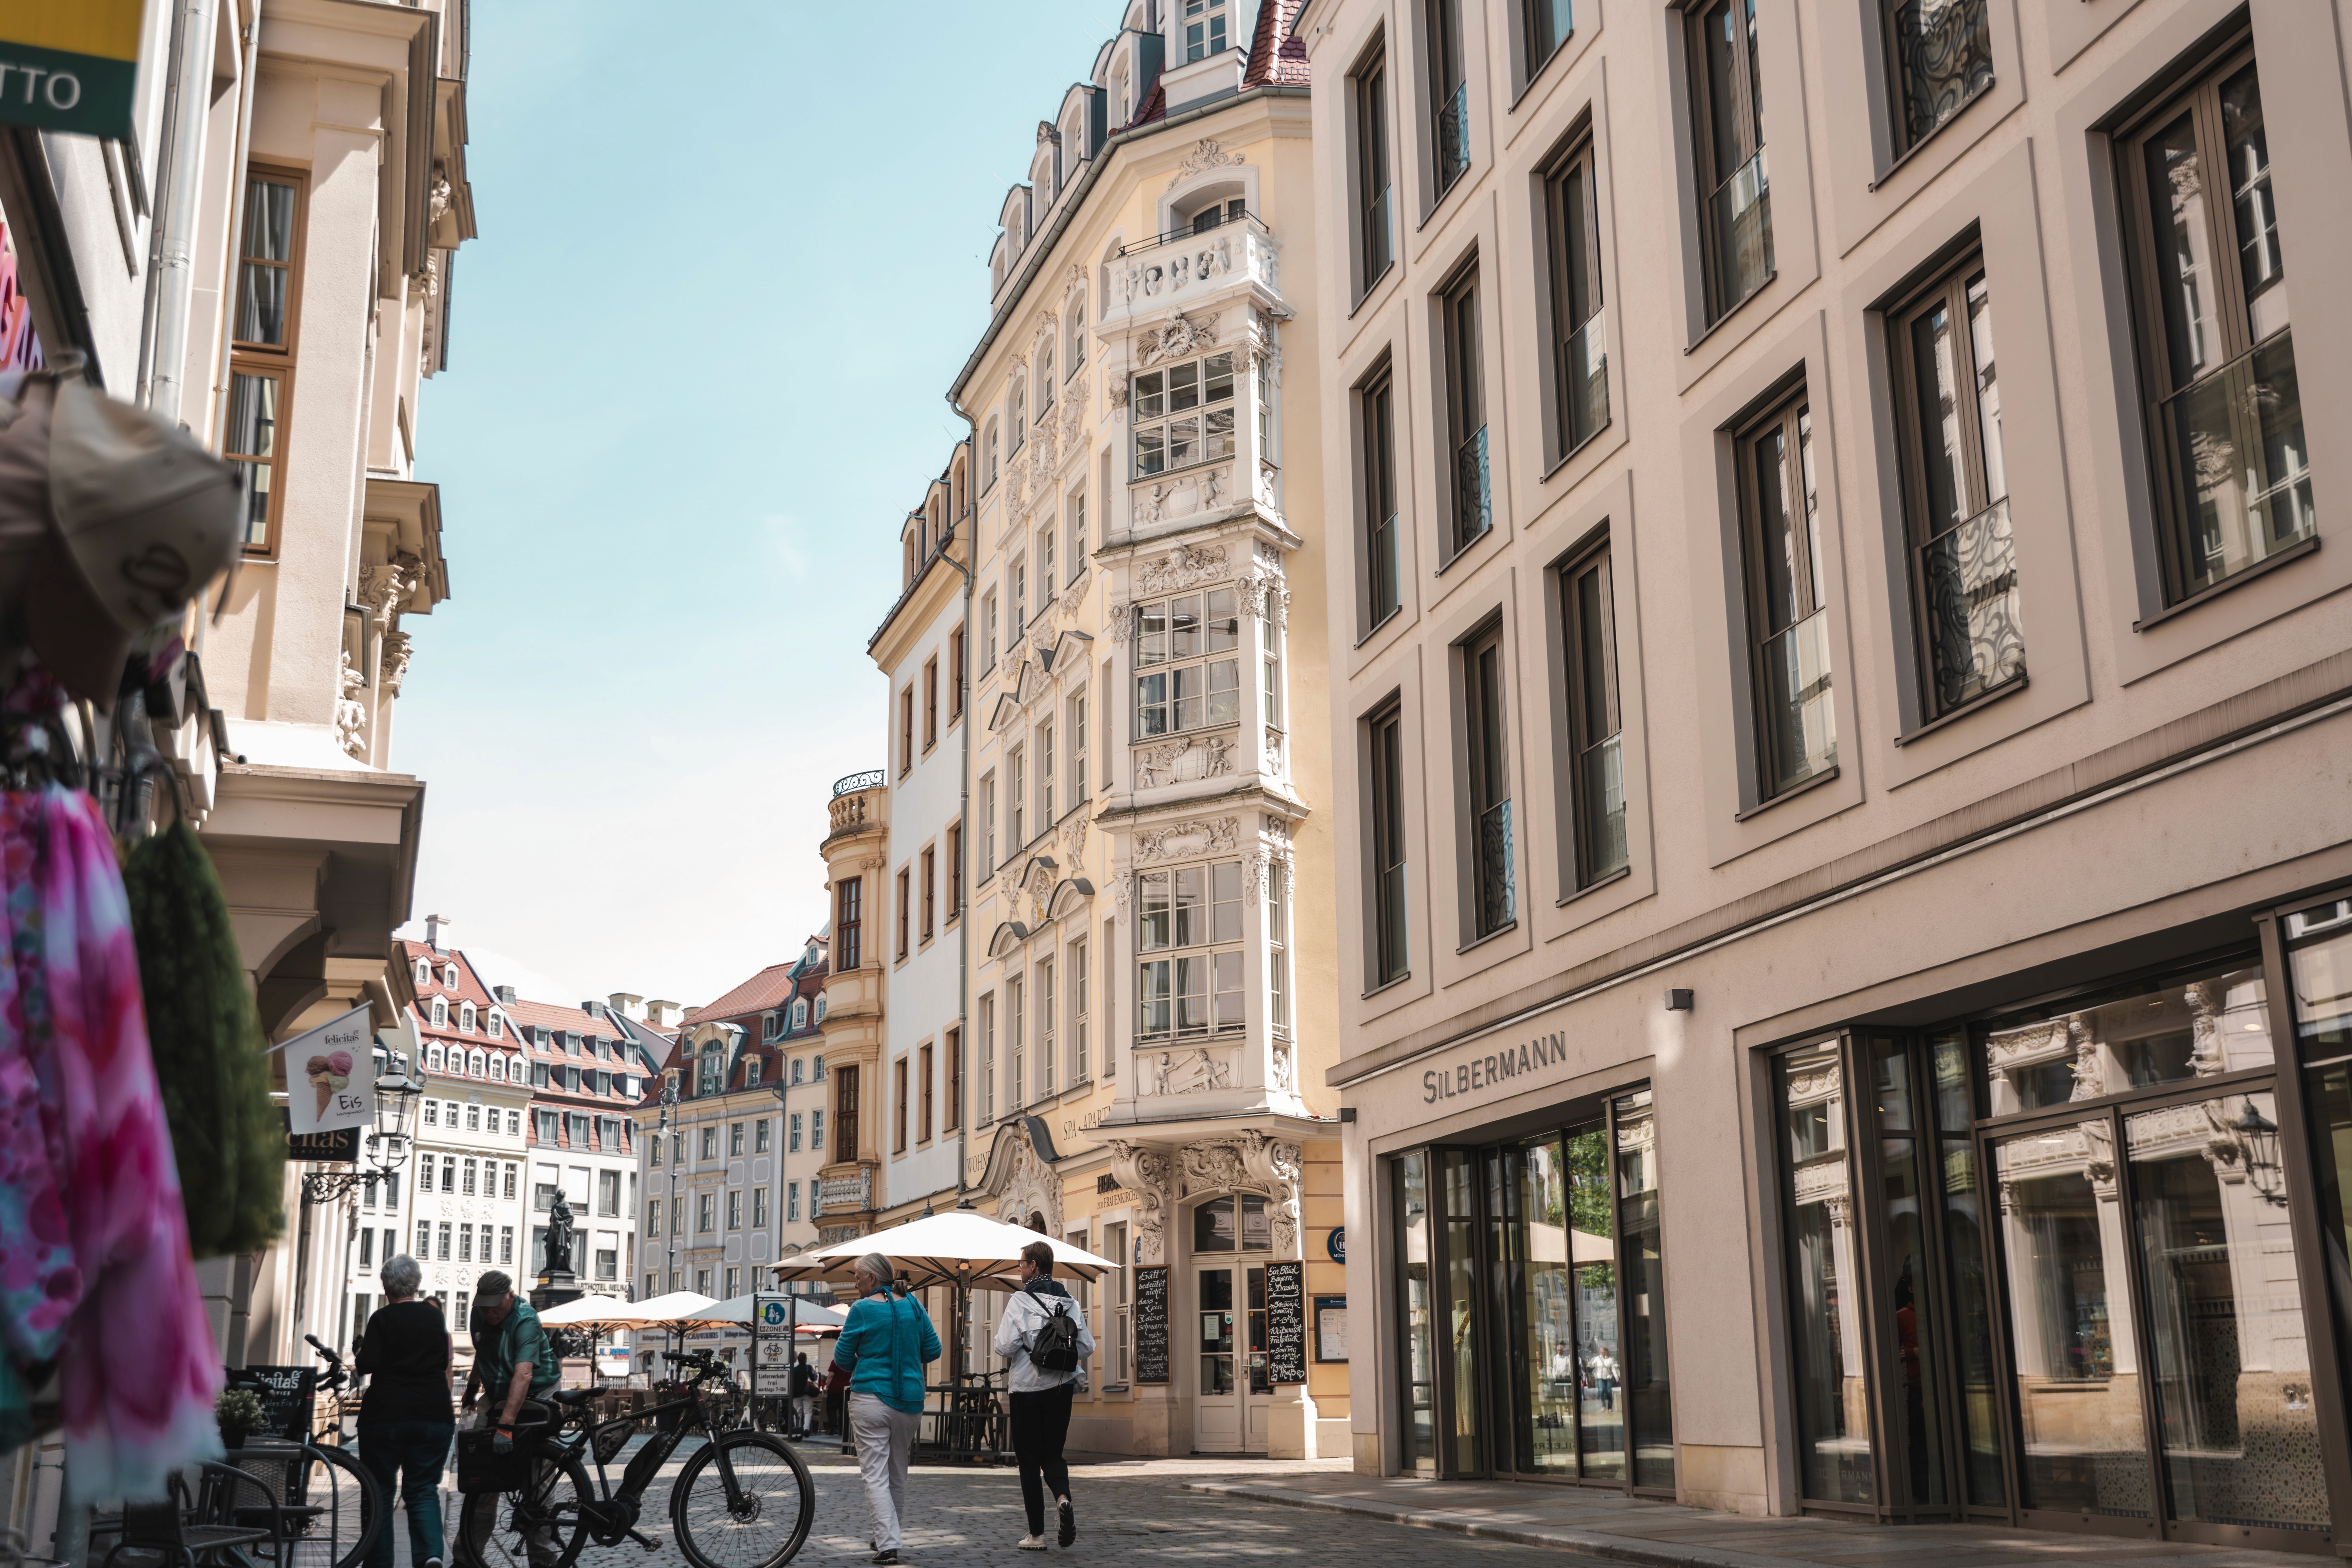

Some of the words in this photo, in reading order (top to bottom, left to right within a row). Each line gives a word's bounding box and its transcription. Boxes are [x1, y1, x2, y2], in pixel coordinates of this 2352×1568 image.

[325, 1033, 359, 1044] felicitas
[338, 1095, 362, 1110] Eis
[1063, 1118, 1077, 1141] SPA
[1268, 1266, 1279, 1276] Ein
[1278, 1265, 1300, 1276] Stück
[1138, 1279, 1167, 1290] bedeutet
[1269, 1276, 1295, 1286] Bayern
[1273, 1281, 1301, 1295] Dresden
[1138, 1312, 1167, 1323] Kaiser-
[1290, 1317, 1300, 1327] Uhr
[1148, 1331, 1163, 1341] mehr
[1270, 1333, 1303, 1347] Frühstück
[1138, 1336, 1167, 1351] reinpasst
[1290, 1354, 1301, 1363] Uhr
[1142, 1362, 1167, 1372] wünscht
